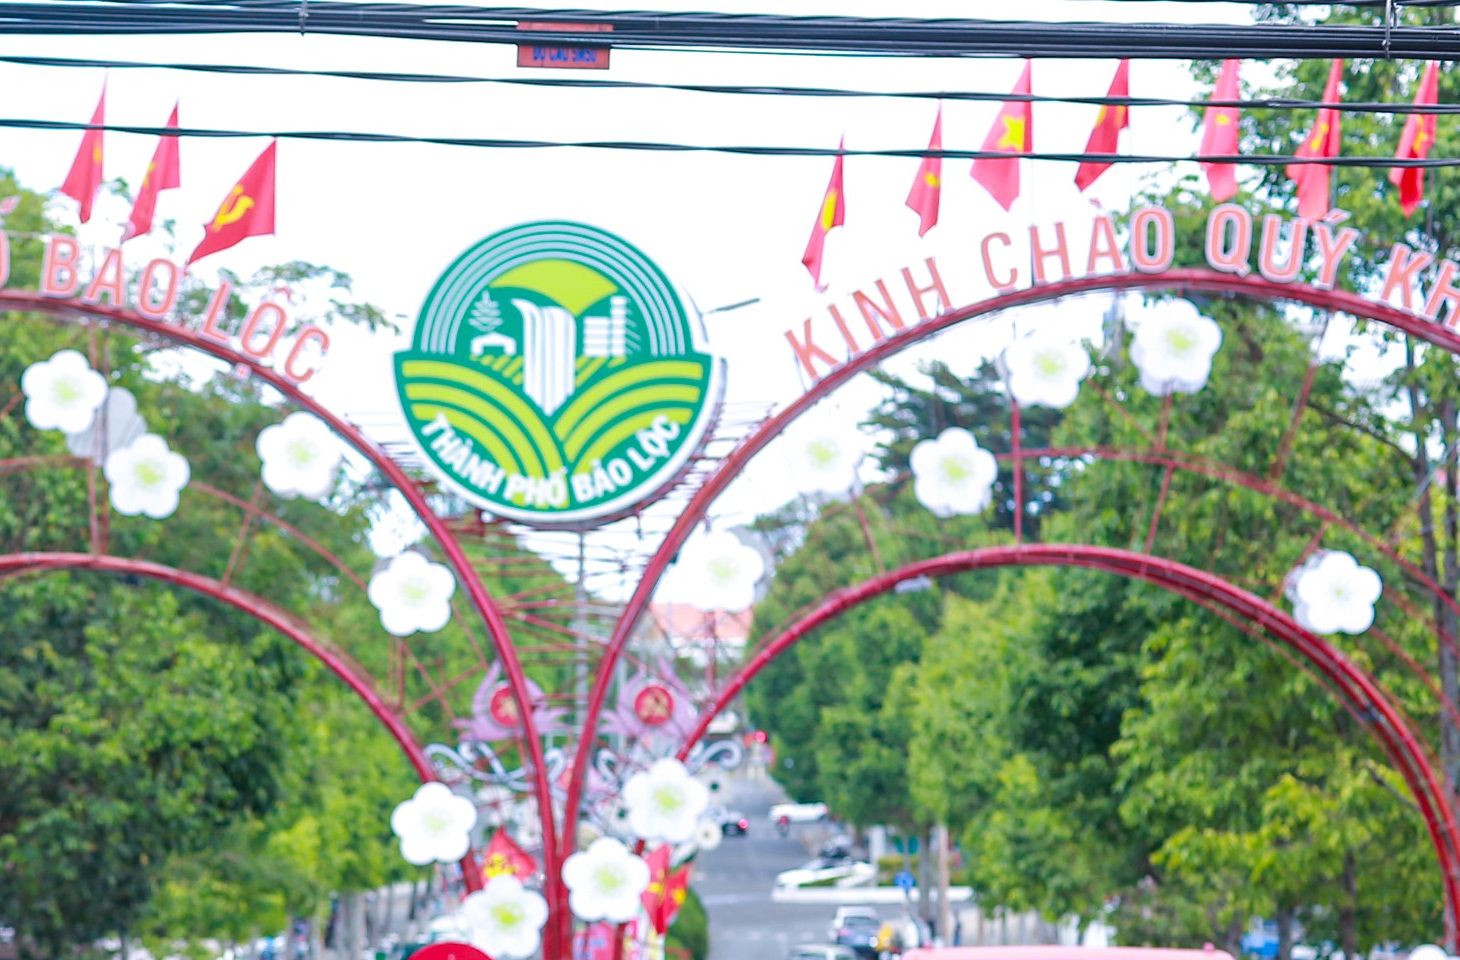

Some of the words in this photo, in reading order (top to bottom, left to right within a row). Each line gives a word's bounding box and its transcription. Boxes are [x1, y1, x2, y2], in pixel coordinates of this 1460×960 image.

[980, 198, 1175, 292] CHÀO
[1205, 203, 1360, 292] QUÝ
[421, 412, 505, 495] THÀNH
[503, 465, 569, 508] PHỐ
[570, 457, 633, 503] BẢO
[627, 414, 681, 471] LỘC
